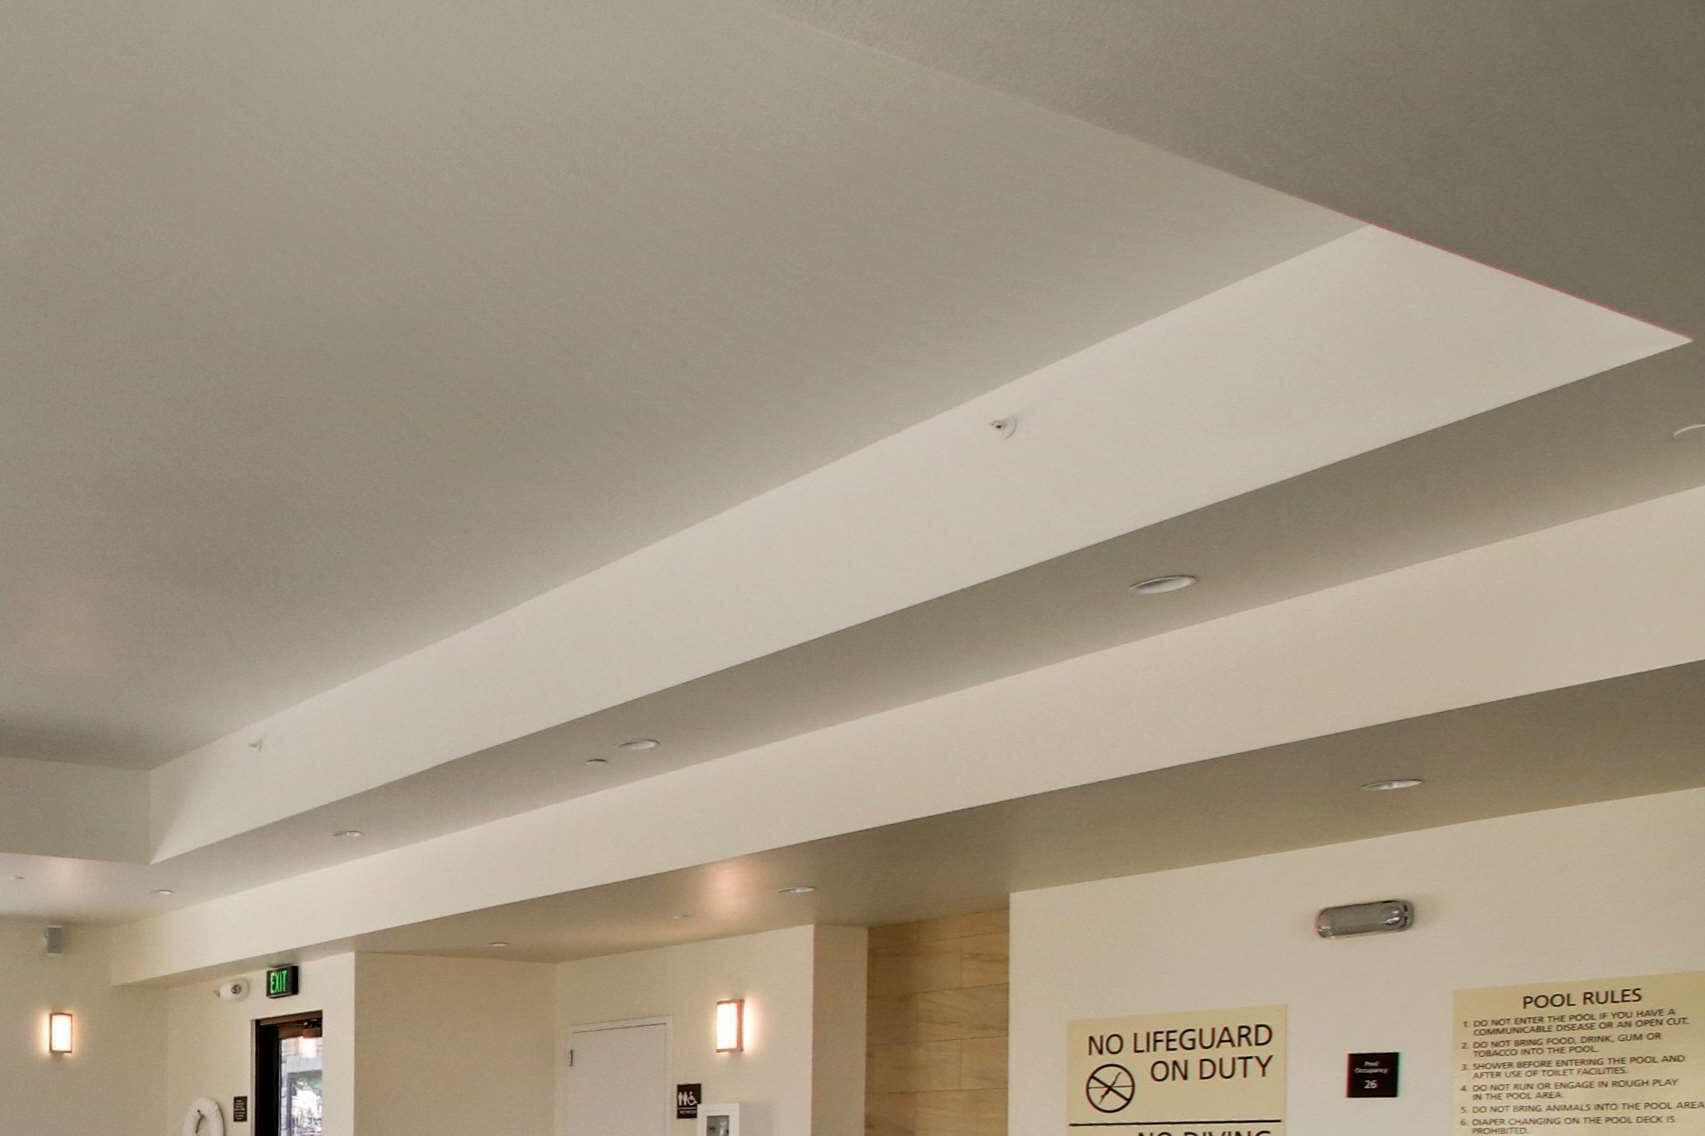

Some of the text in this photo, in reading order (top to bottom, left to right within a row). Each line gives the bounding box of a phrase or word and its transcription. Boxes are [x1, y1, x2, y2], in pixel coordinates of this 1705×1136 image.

[271, 970, 287, 993] EXIT
[1522, 988, 1642, 1009] POOL RULES
[1491, 1018, 1511, 1026] NOT
[1514, 1016, 1544, 1025] ENTER
[1569, 1013, 1596, 1021] POOL
[1611, 1011, 1633, 1019] YOU
[1636, 1009, 1664, 1018] HAVE
[1473, 1025, 1552, 1036] COMMUNICABLE
[1556, 1023, 1595, 1032] DISEASE
[1598, 1021, 1613, 1029] OR
[1617, 1020, 1632, 1028] AN
[1635, 1019, 1664, 1027] OPEN
[1088, 1024, 1273, 1056] NO LIFEGUARD
[1473, 1041, 1488, 1049] DO
[1491, 1040, 1511, 1048] NOT
[1514, 1039, 1543, 1047] BRING
[1617, 1034, 1643, 1042] GUM
[1646, 1032, 1661, 1040] OR
[1473, 1049, 1518, 1057] TOBACCO
[1521, 1047, 1544, 1055] INTO
[1150, 1055, 1273, 1082] ON DUTY
[1473, 1062, 1513, 1070] SHOWER
[1517, 1060, 1553, 1068] BEFORE
[1556, 1058, 1604, 1068] ENTERING
[1608, 1057, 1626, 1065] THE
[1629, 1056, 1659, 1064] POOL
[1473, 1071, 1501, 1079] AFTER
[1473, 1084, 1487, 1092] DO
[1536, 1082, 1551, 1090] OR
[1554, 1081, 1595, 1089] ENGAGE
[1598, 1080, 1608, 1088] IN
[1611, 1079, 1649, 1087] ROUGH
[1652, 1078, 1679, 1087] PLAY
[1490, 1105, 1510, 1113] NOT
[1545, 1103, 1591, 1112] ANIMALS
[1594, 1103, 1618, 1111] INTO
[1621, 1102, 1640, 1110] THE
[1644, 1102, 1672, 1110] POOL
[1508, 1117, 1561, 1126] CHANGING
[1564, 1117, 1580, 1125] ON
[1605, 1116, 1632, 1124] POOL
[1636, 1116, 1664, 1124] DECK
